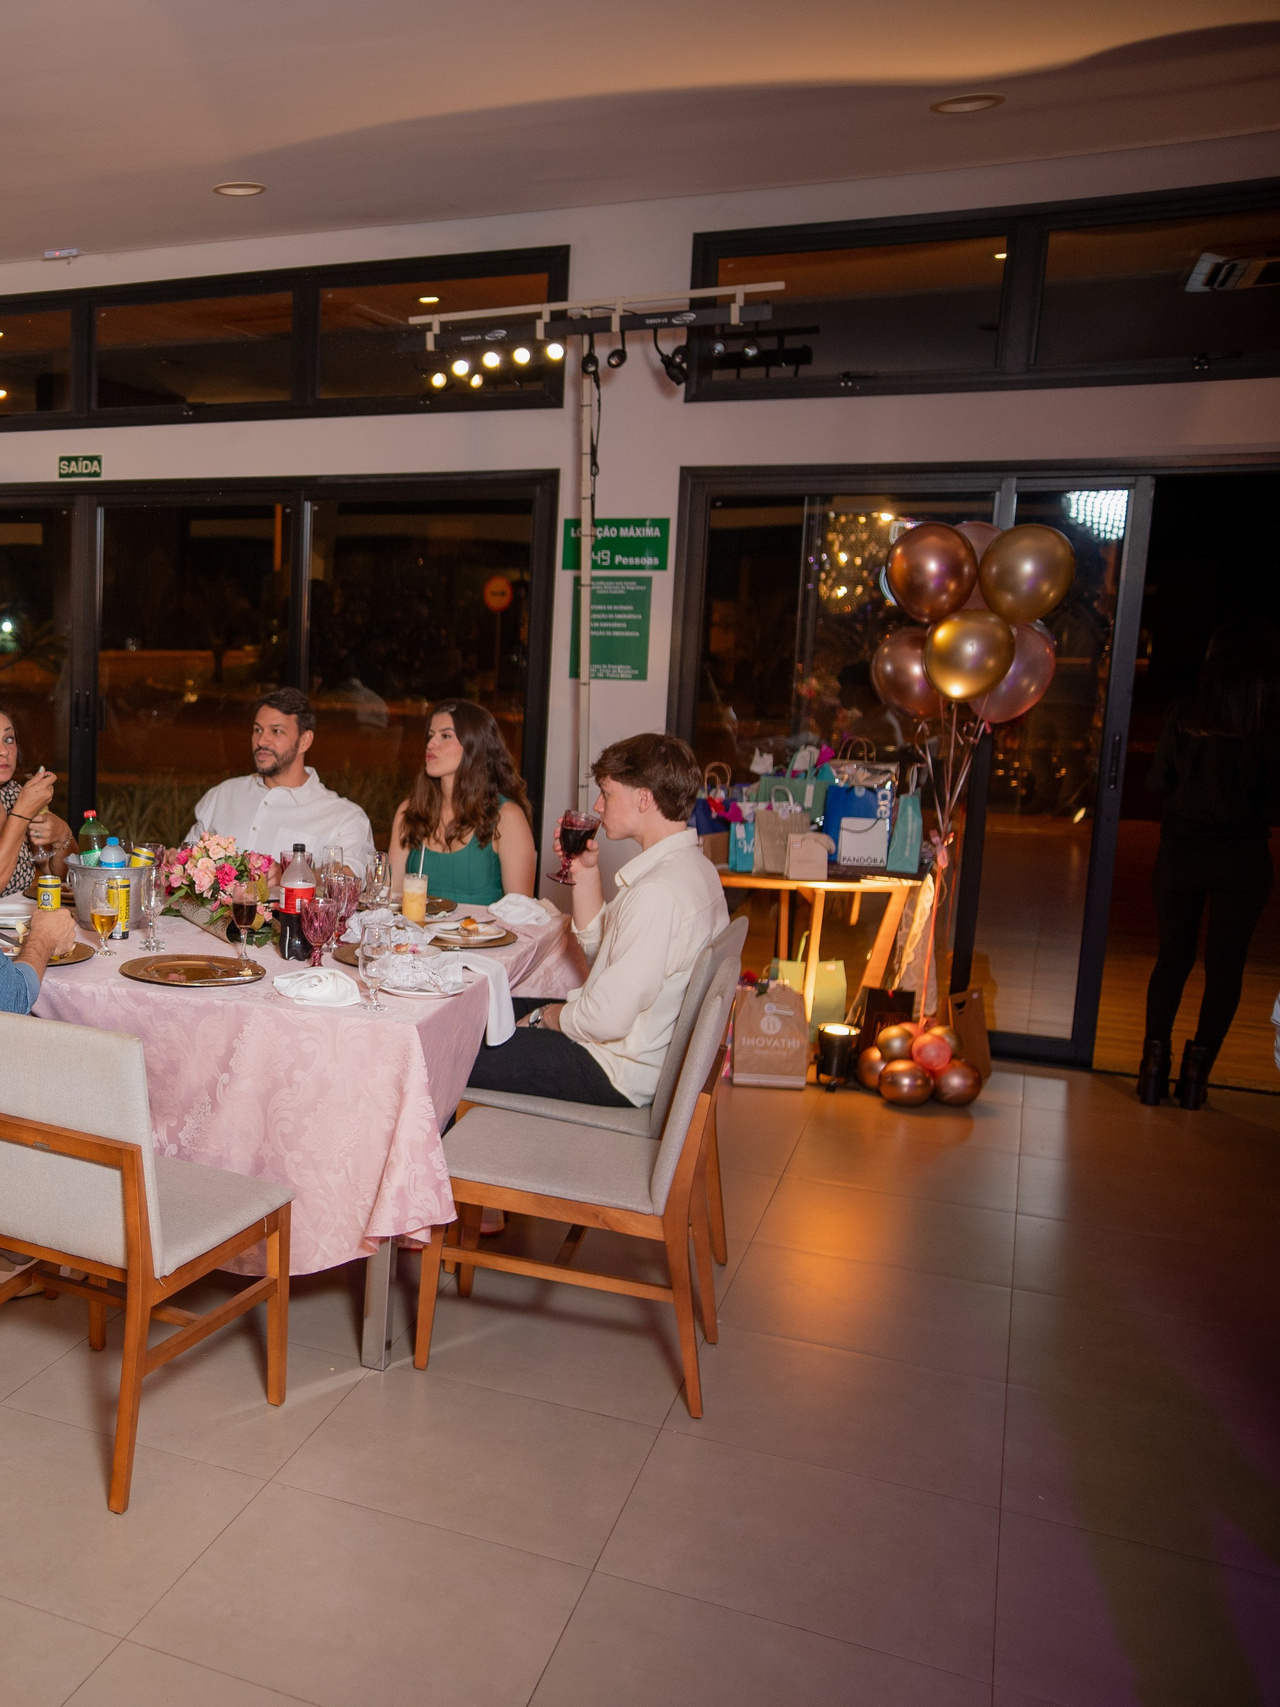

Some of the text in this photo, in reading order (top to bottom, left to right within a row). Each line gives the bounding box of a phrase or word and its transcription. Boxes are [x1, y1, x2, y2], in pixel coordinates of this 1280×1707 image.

[60, 457, 101, 473] SAÍDA
[571, 524, 661, 539] LOÇÃO MÁXIMA
[591, 550, 659, 565] 49 Pessoas
[842, 855, 885, 864] PANDORA
